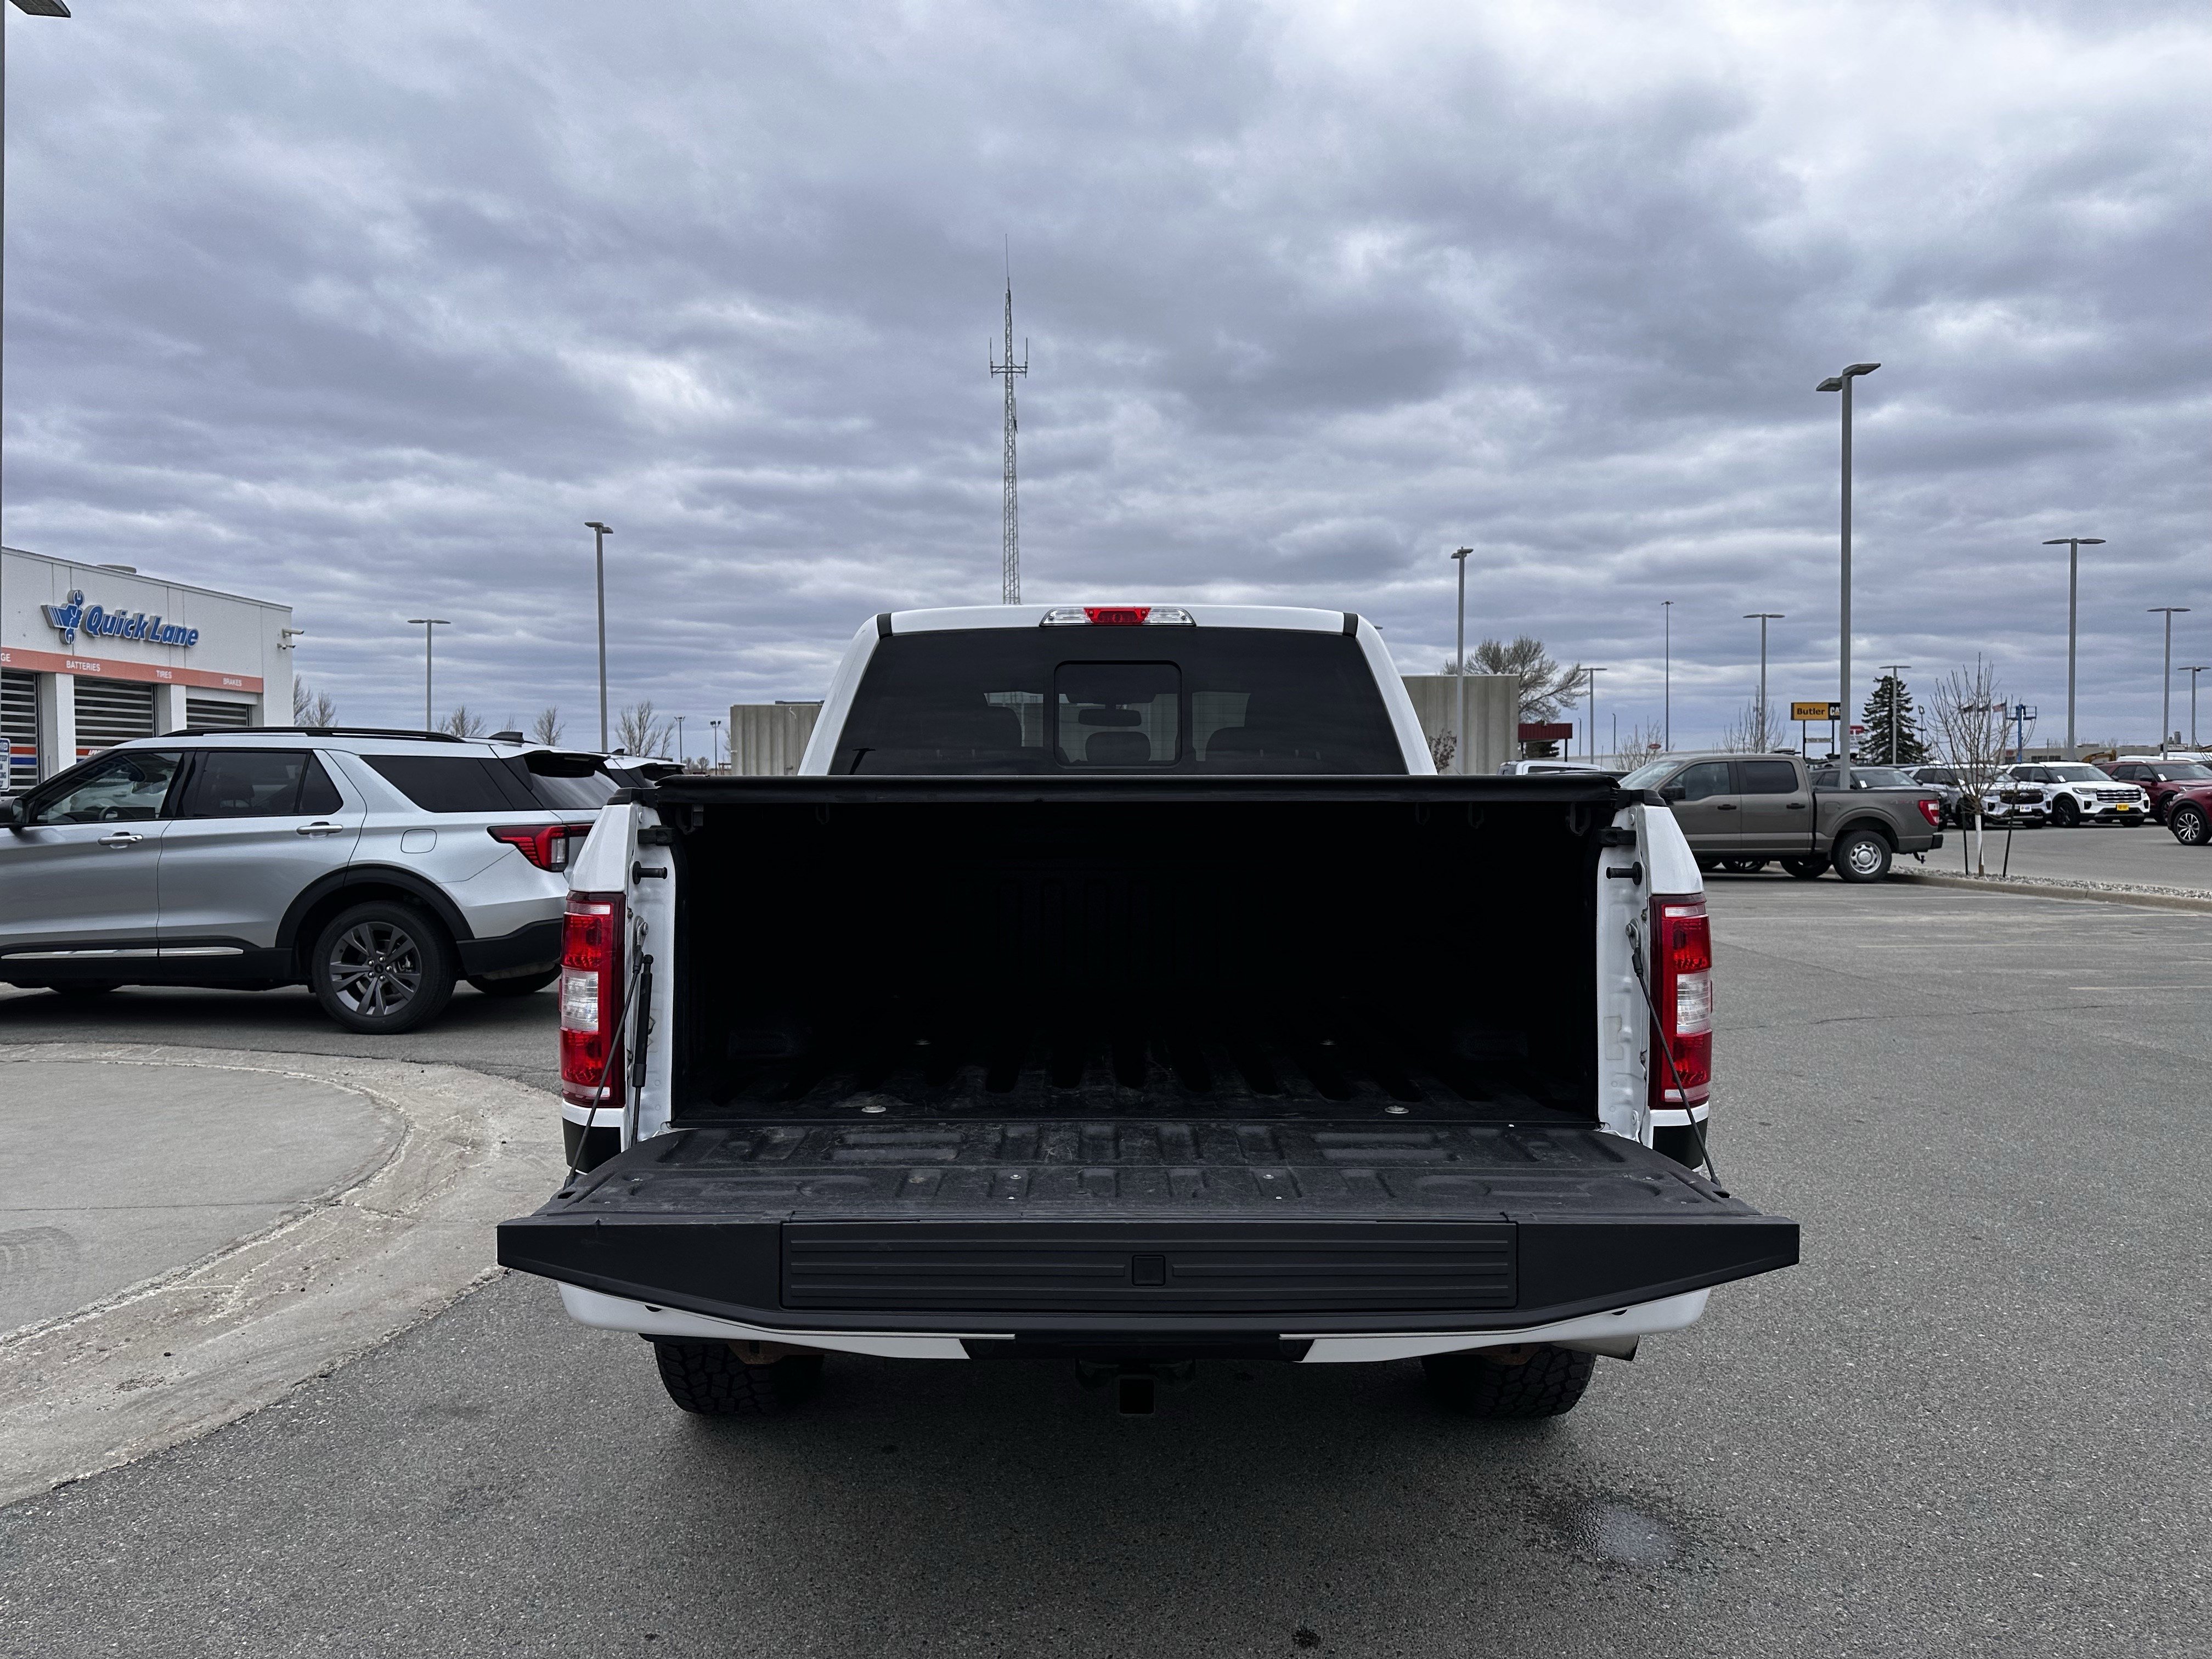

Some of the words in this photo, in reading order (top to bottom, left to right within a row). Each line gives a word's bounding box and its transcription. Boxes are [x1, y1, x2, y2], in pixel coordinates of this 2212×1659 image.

[86, 604, 148, 640] Quick
[149, 616, 199, 647] Lane
[66, 660, 100, 672] BATTERIES
[156, 670, 172, 679] TIRES
[1830, 706, 1841, 716] CA
